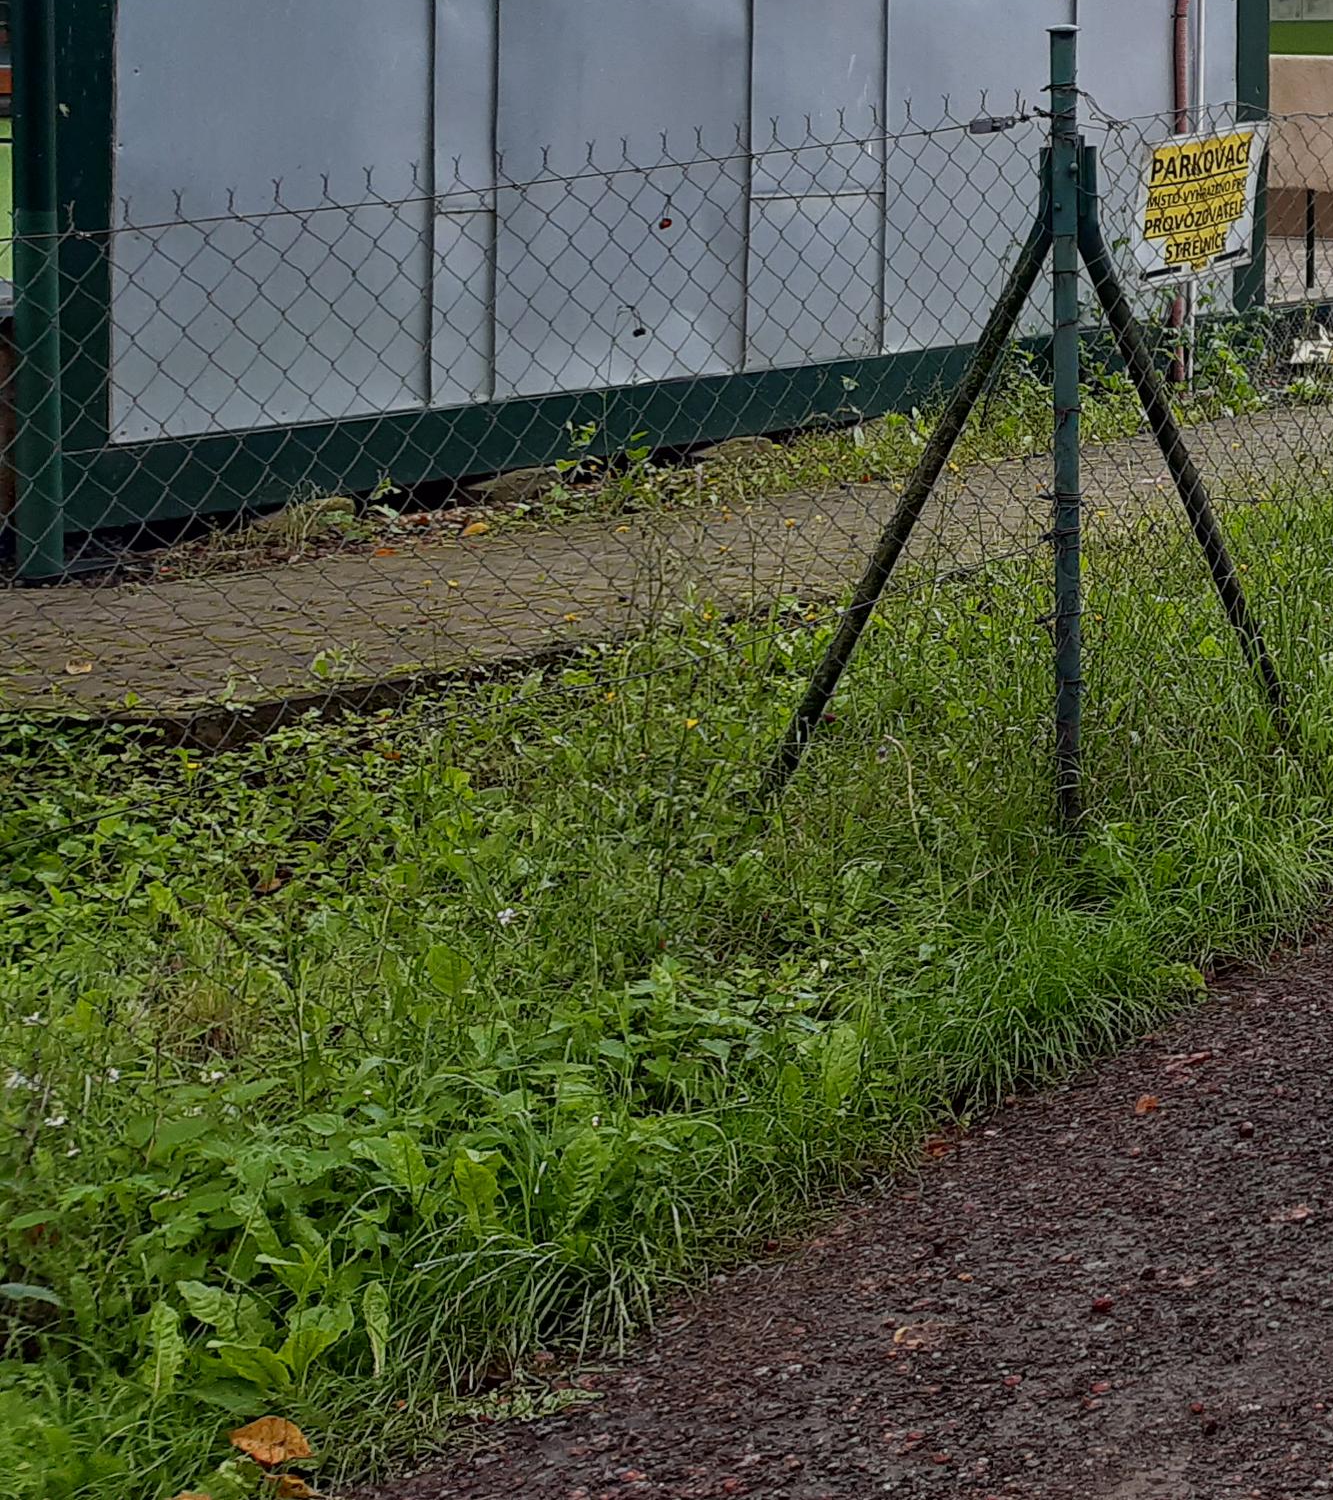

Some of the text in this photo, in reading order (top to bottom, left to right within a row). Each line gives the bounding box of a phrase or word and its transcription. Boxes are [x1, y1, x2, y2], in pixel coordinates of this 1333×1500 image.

[1150, 133, 1254, 182] PARKOVACÍ
[1144, 197, 1246, 238] PROVOZOVATELE
[1164, 231, 1227, 261] STŘELNICE
